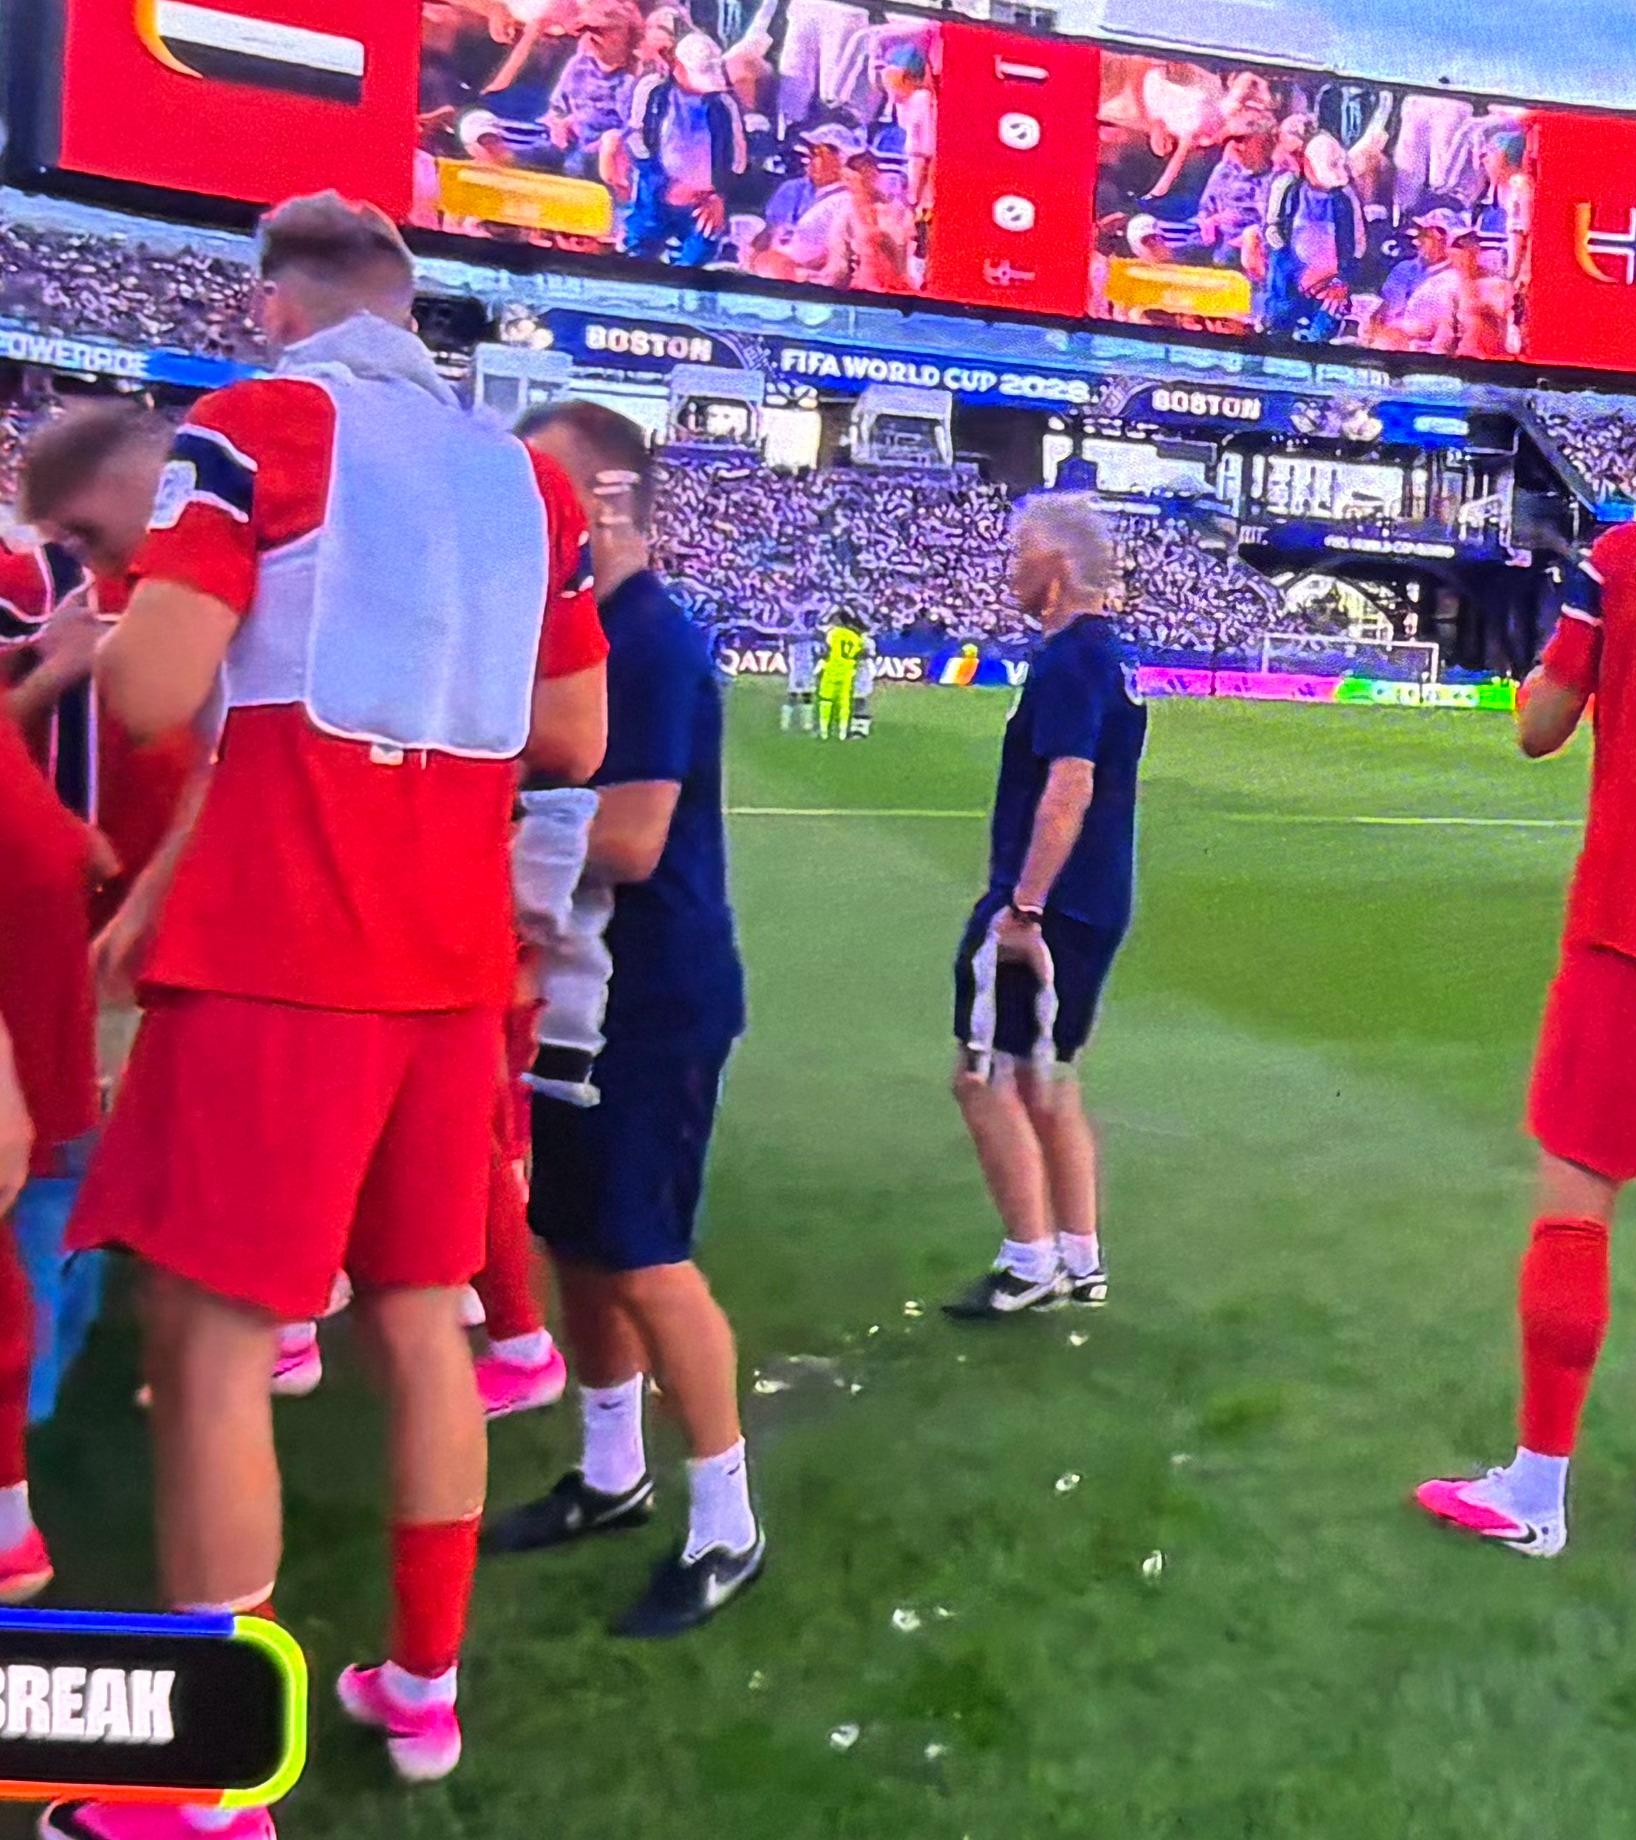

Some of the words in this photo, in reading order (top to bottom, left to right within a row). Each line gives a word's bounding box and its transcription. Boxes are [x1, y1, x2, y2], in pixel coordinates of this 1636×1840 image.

[585, 324, 713, 362] BOSTON
[780, 349, 841, 377] FIFA
[842, 354, 940, 387] WORLD
[943, 367, 997, 392] CUP
[1151, 389, 1262, 420] BOSTON
[715, 648, 789, 676] QATA
